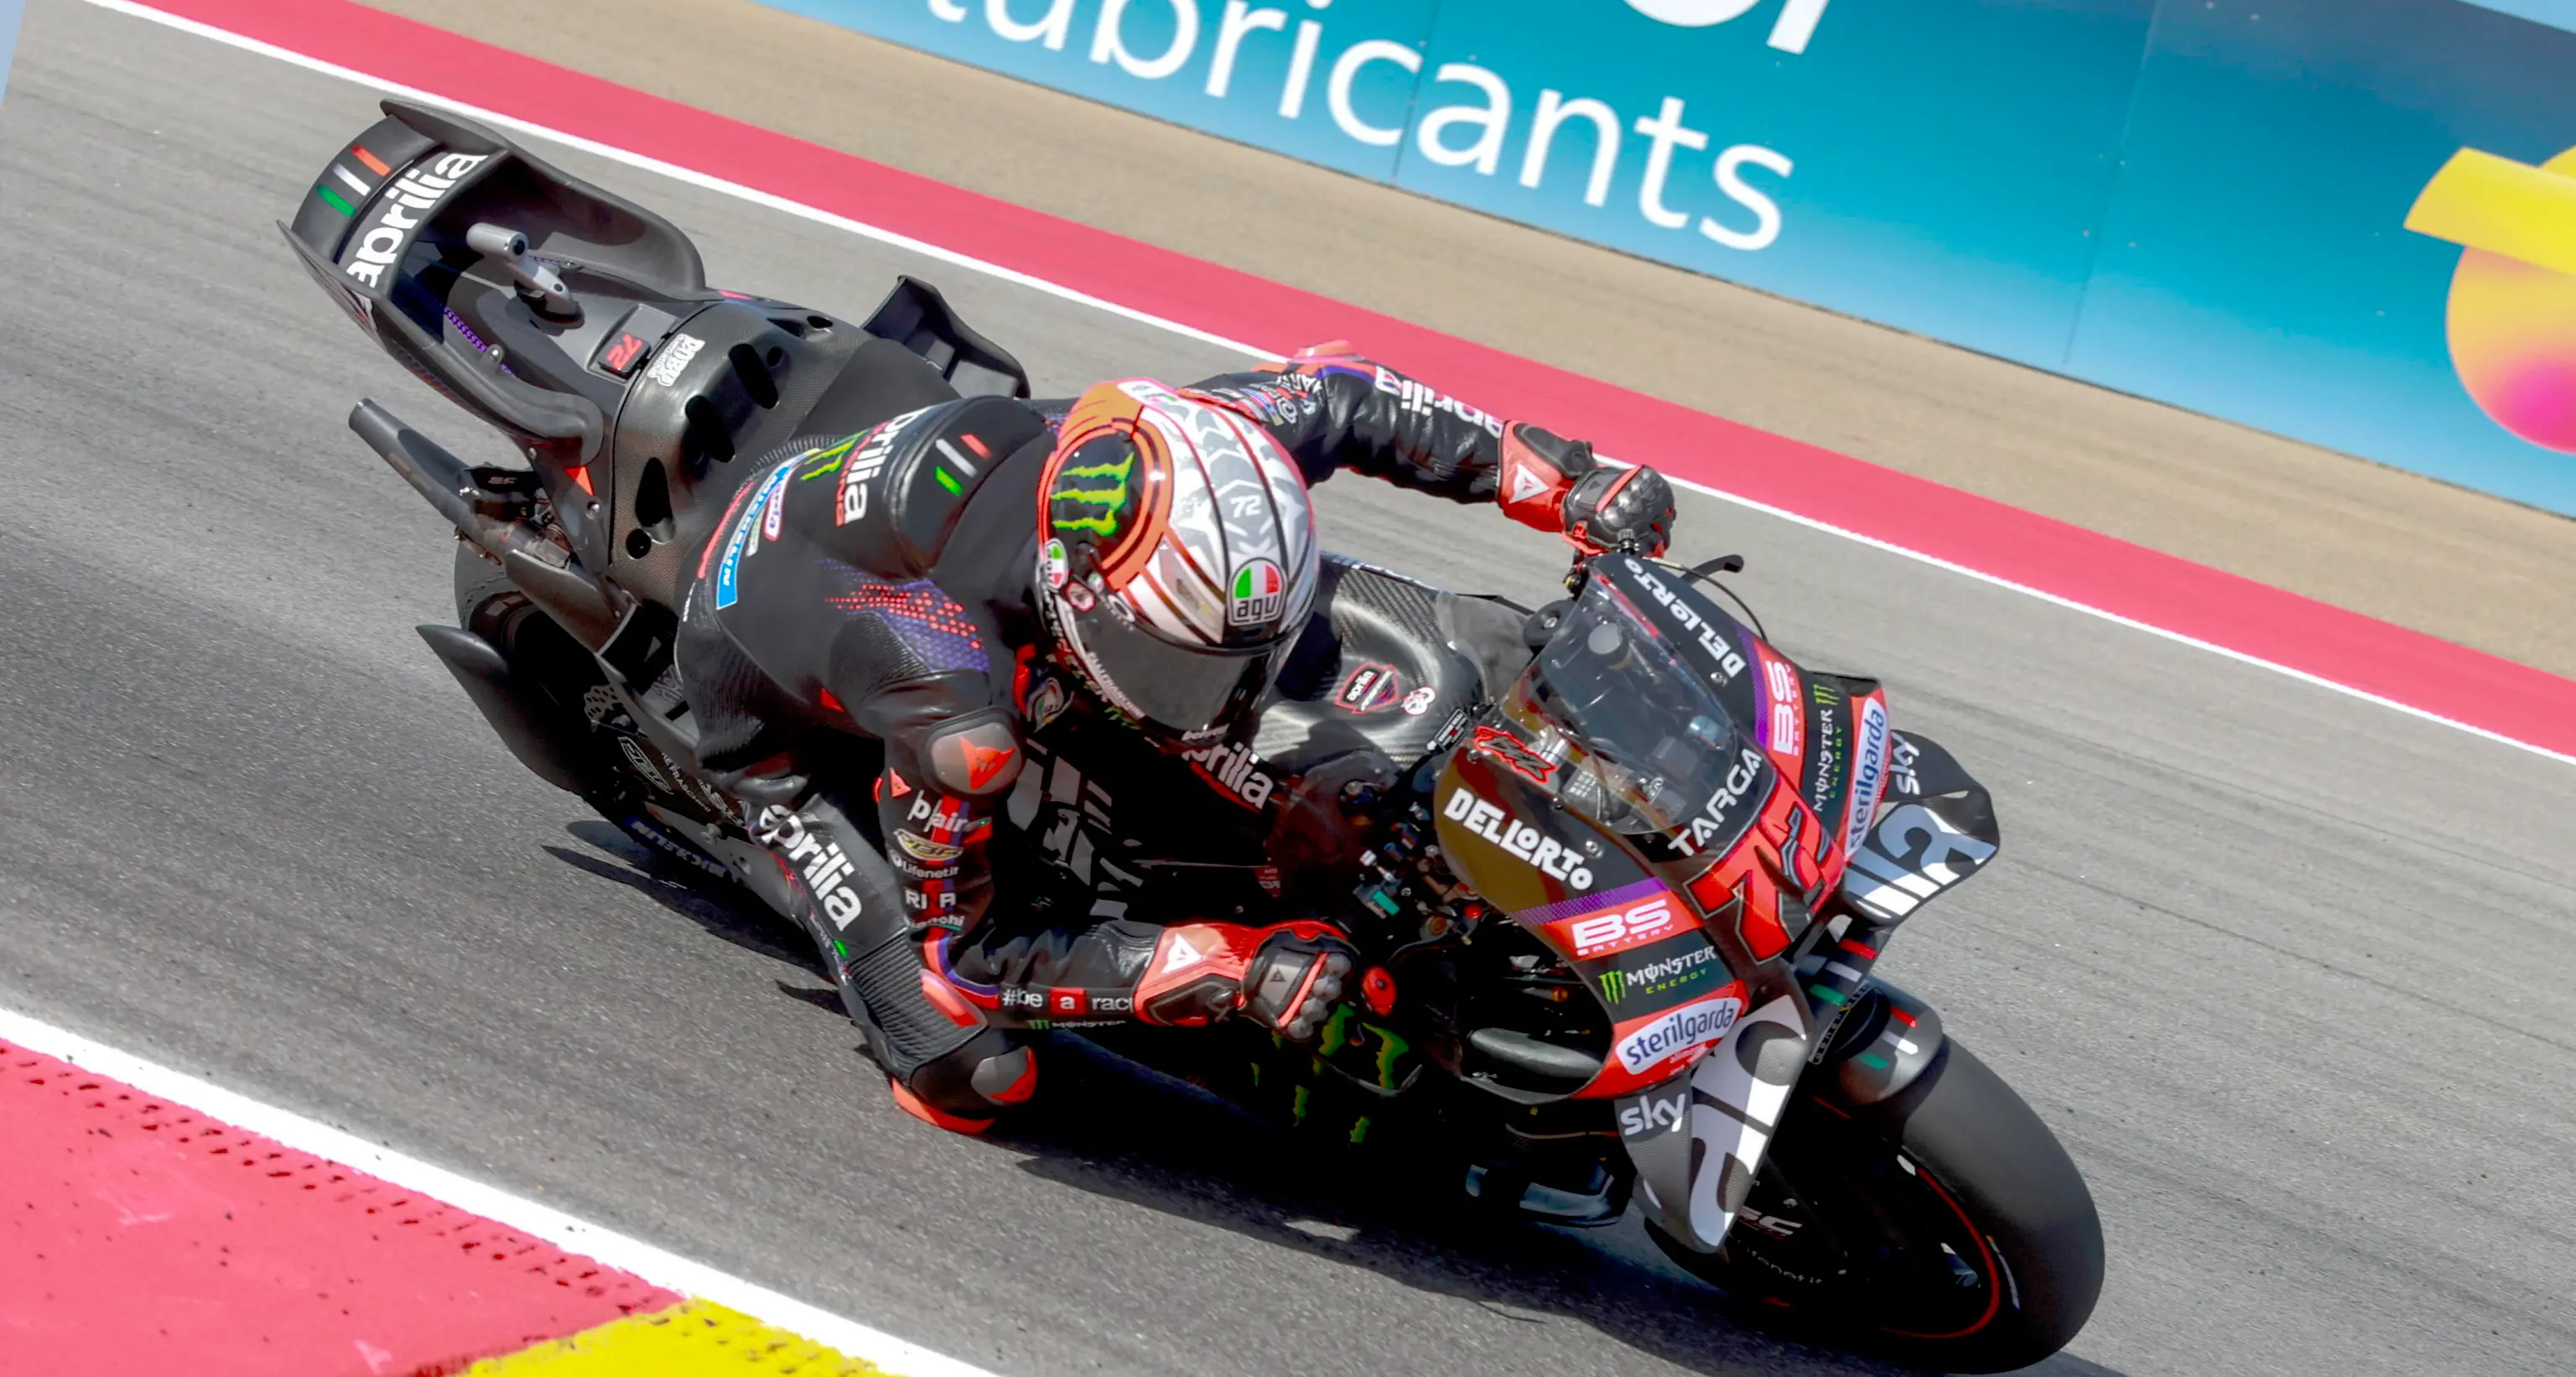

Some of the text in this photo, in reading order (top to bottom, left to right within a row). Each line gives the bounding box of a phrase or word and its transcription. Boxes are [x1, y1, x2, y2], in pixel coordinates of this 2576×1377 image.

[927, 0, 1794, 252] ubricants
[345, 152, 489, 289] aprilia
[844, 406, 932, 524] prilia
[1230, 495, 1261, 518] 72
[1233, 596, 1280, 621] agv
[1766, 661, 1794, 755] BS
[1667, 748, 1763, 857] TARGA
[1813, 709, 1834, 813] MONSTER
[1848, 707, 1886, 850] sterilgarda
[1888, 731, 1920, 796] sky
[760, 803, 863, 932] aprilia
[1443, 787, 1593, 891] DELLORTO
[1682, 801, 1845, 965] 72
[1571, 899, 1672, 949] BS
[1626, 945, 1718, 987] MONSTER
[1059, 995, 1076, 1010] a
[1092, 995, 1134, 1013] rac
[1644, 968, 1708, 995] ENERGY
[1625, 1002, 1736, 1065] sterilgarda
[1620, 1093, 1685, 1136] sky
